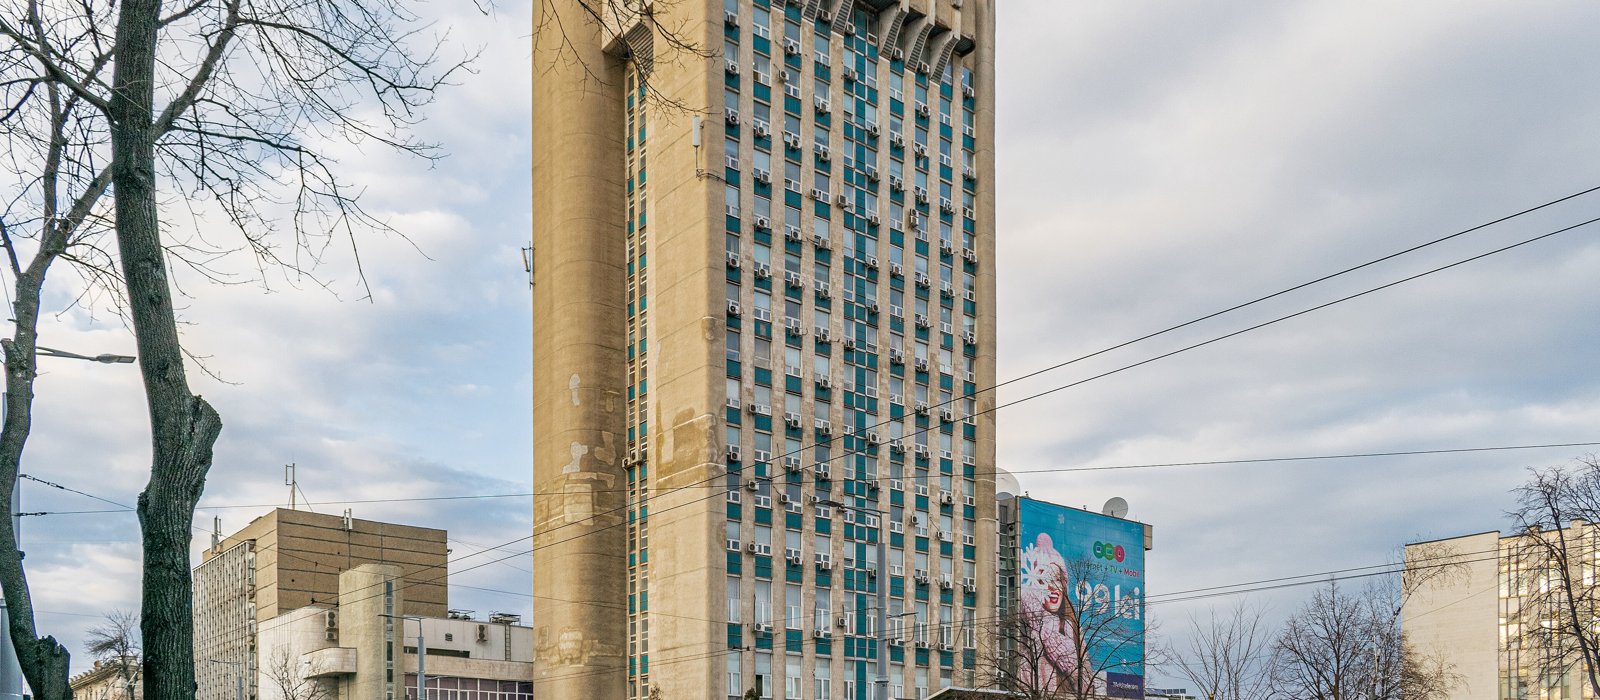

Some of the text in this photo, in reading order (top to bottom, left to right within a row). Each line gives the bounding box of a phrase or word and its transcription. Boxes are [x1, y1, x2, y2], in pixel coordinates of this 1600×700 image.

[1110, 565, 1118, 574] TV
[1123, 567, 1140, 578] Mobil
[1075, 580, 1140, 620] 99 lei
